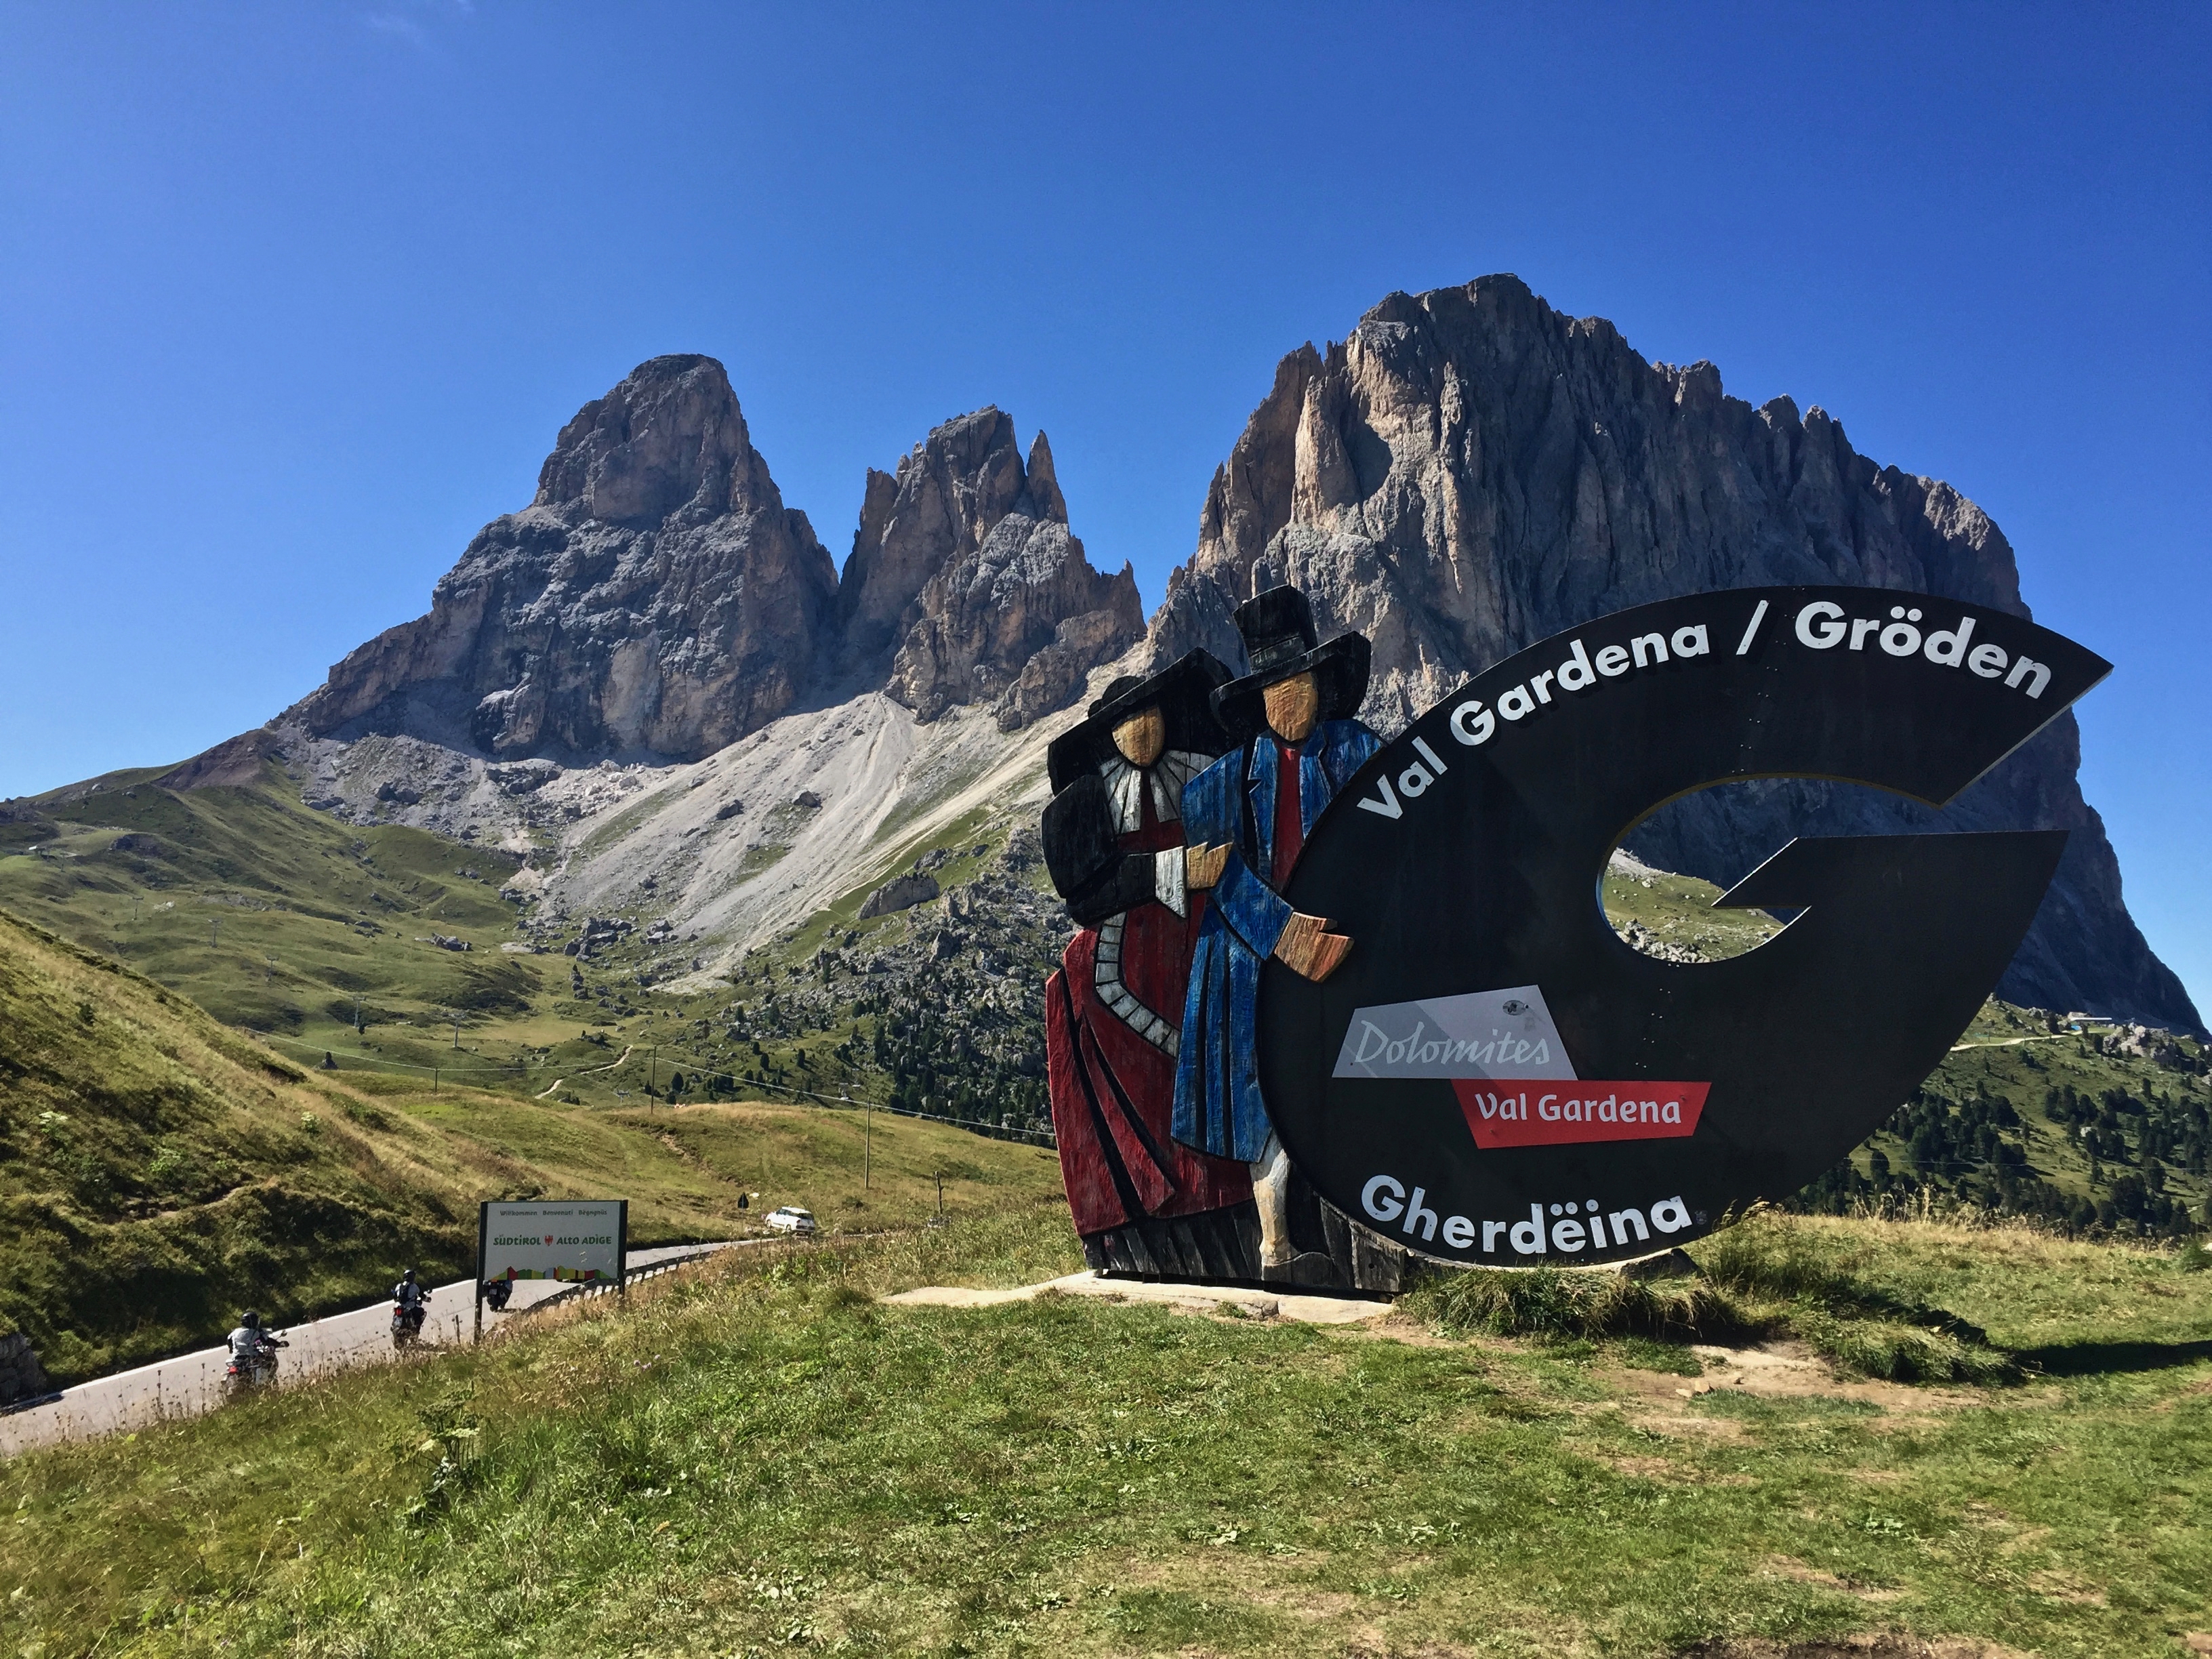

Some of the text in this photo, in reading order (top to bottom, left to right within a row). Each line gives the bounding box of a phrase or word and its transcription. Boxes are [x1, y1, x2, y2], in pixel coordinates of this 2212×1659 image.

[1357, 736, 1449, 819] Val
[1450, 623, 1711, 746] Gardena
[1795, 601, 2051, 699] Gröden
[1355, 1020, 1551, 1065] Dolomites
[1475, 1093, 1682, 1124] Val Gardena
[1361, 1174, 1693, 1255] Gherdëina
